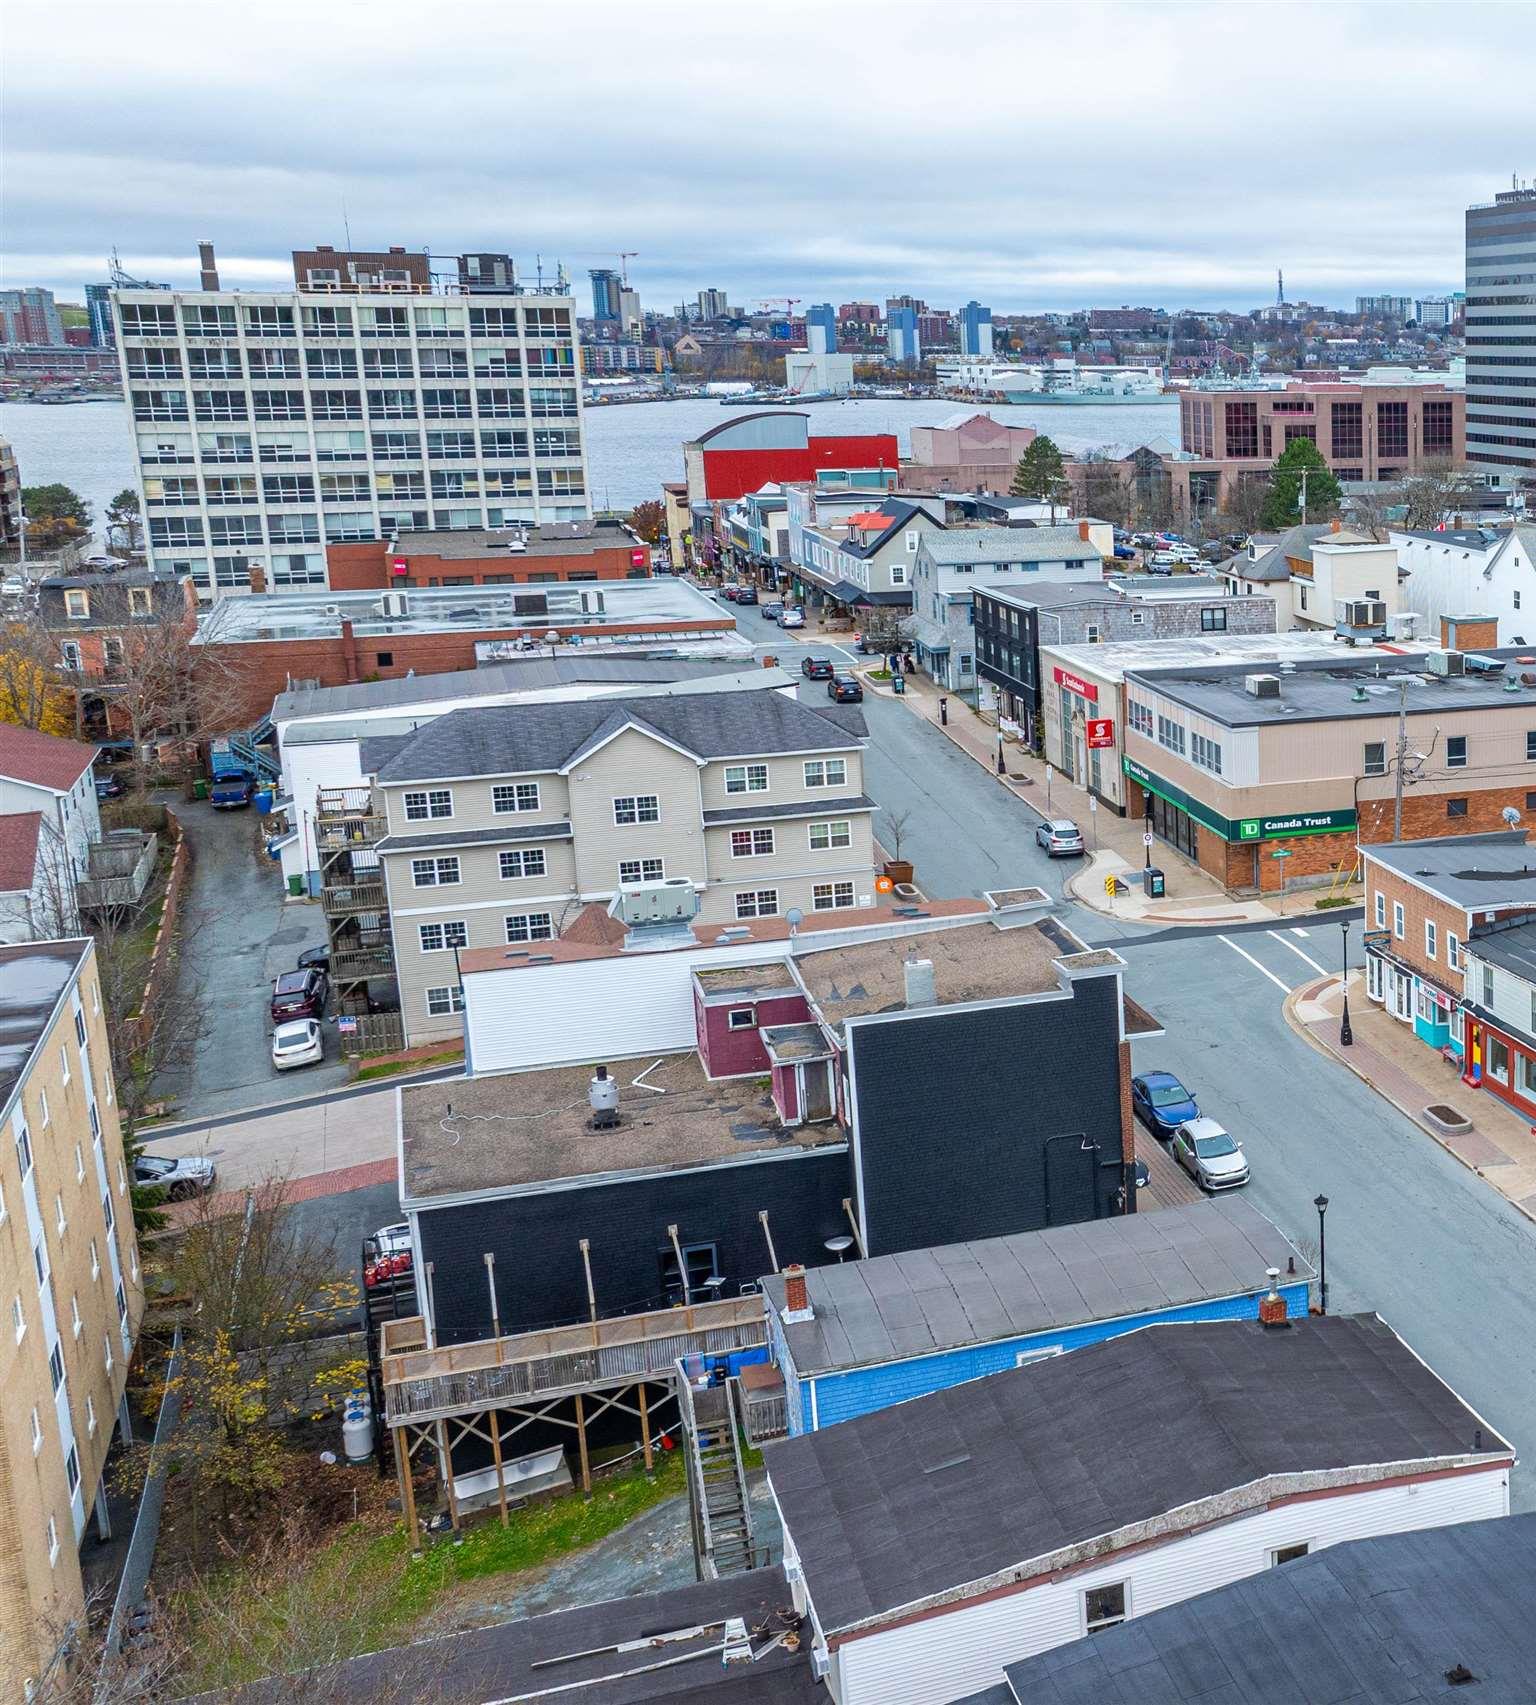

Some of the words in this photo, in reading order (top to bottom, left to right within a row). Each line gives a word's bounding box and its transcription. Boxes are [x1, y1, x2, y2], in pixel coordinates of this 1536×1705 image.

[1242, 823, 1258, 835] TD
[1264, 819, 1302, 830] Canada
[1303, 816, 1332, 825] Trust
